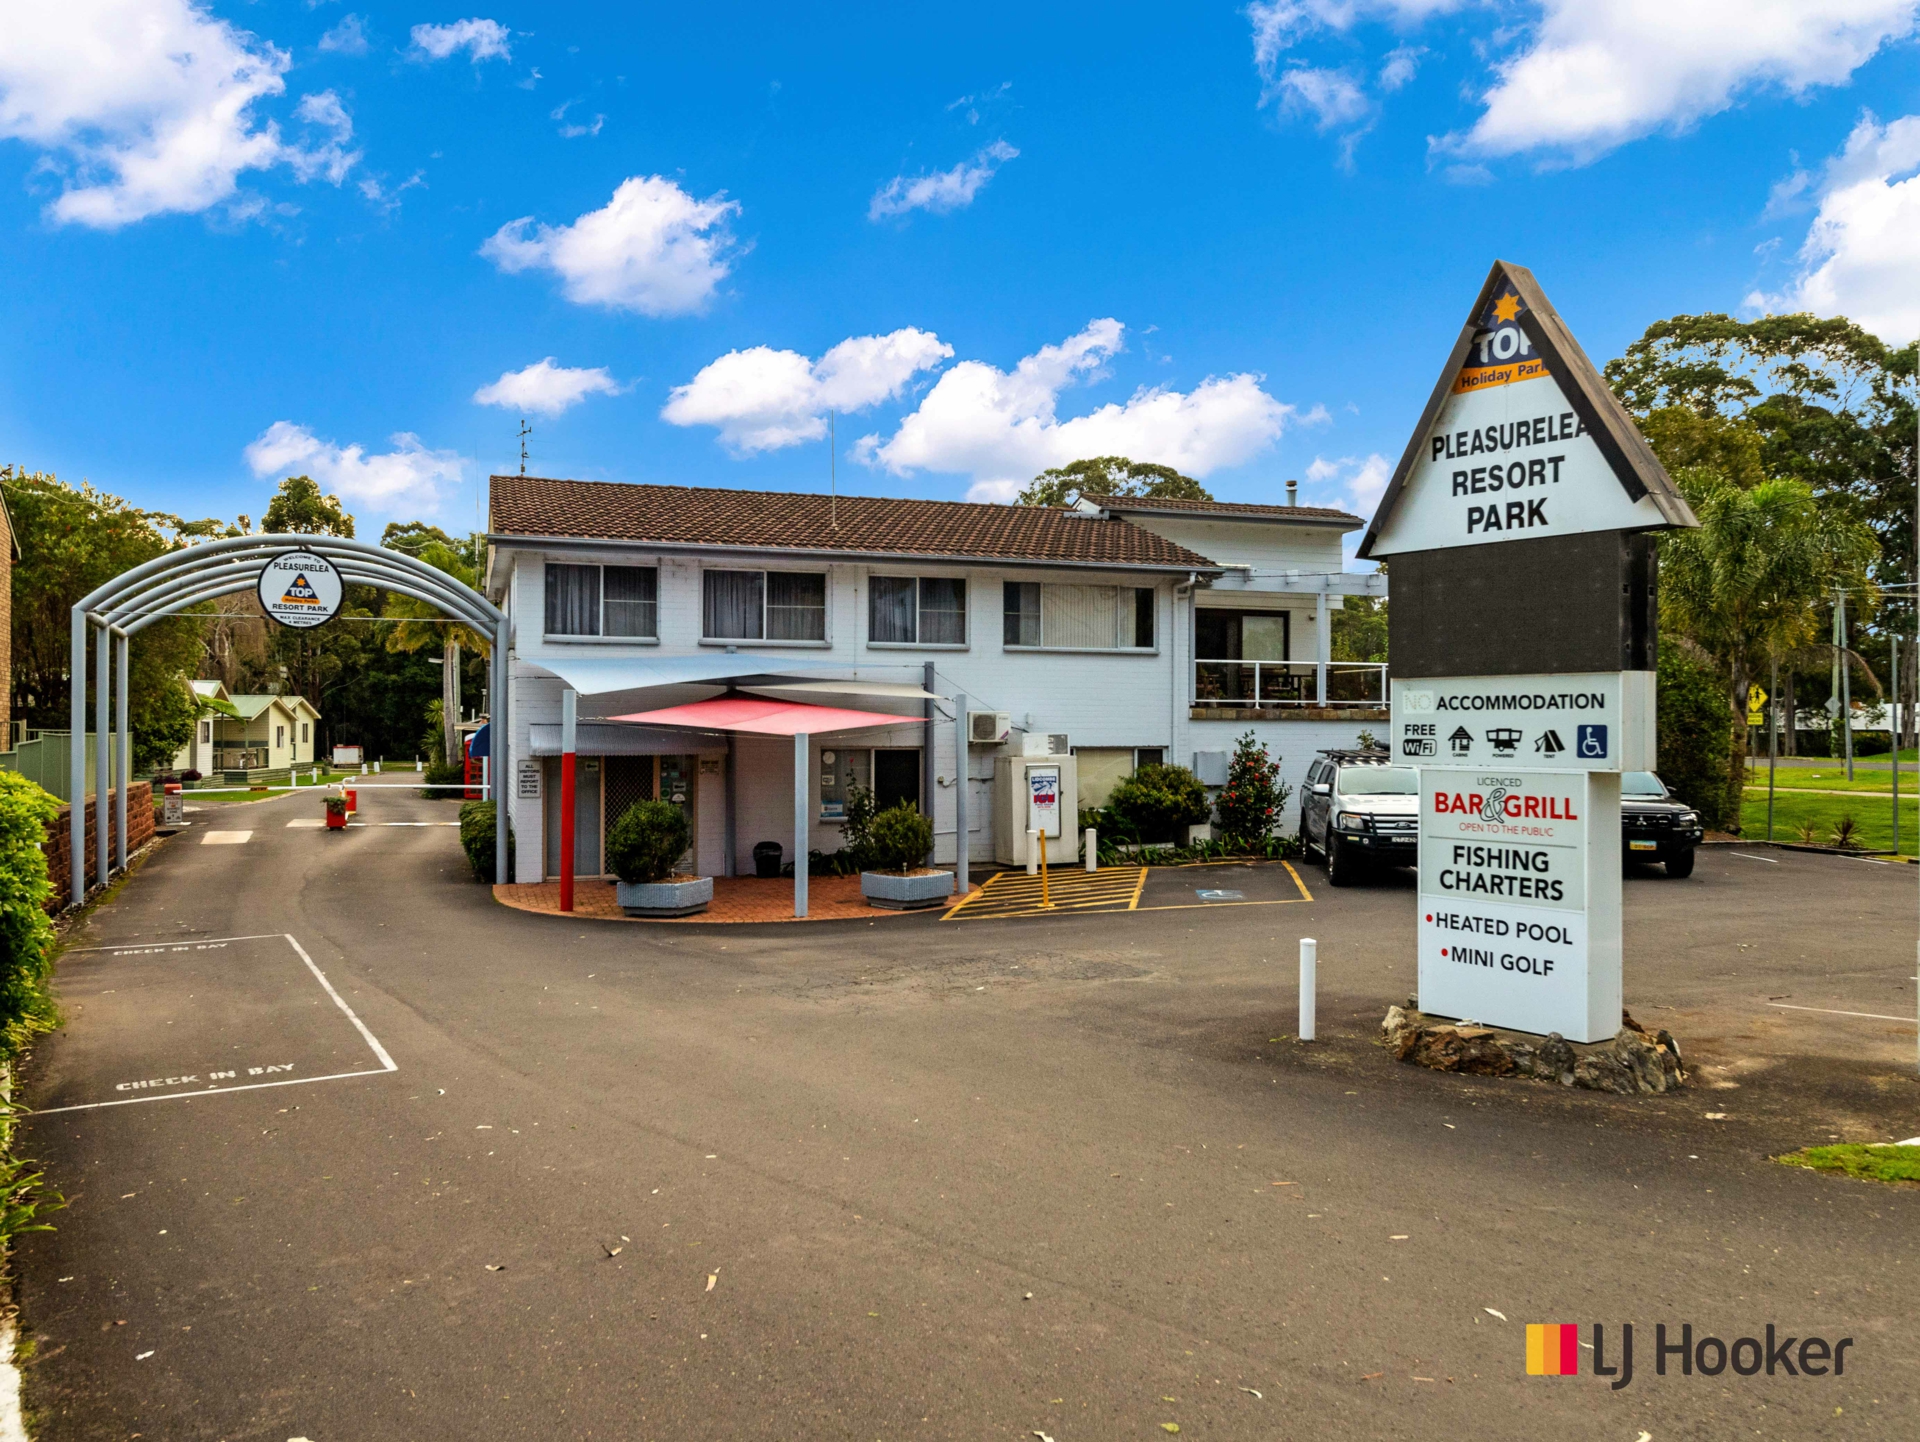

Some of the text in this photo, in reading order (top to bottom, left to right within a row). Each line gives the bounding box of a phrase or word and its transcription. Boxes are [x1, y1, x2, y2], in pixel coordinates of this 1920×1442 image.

[1462, 369, 1513, 388] Holiday
[1432, 412, 1592, 461] PLEASURELEA
[1452, 455, 1565, 497] RESORT
[1467, 498, 1548, 534] PARK
[273, 562, 329, 572] PLEASURELEA
[289, 587, 313, 597] TOP
[1404, 693, 1605, 711] NO ACCOMMODATION
[1404, 724, 1436, 736] FREE
[1477, 777, 1522, 787] LICENCED
[1459, 822, 1554, 837] OPEN TO THE PUBLIC
[1453, 845, 1549, 873] FISHING
[1439, 869, 1563, 901] CHARTERS
[1436, 912, 1573, 945] HEATED POOL
[113, 948, 167, 956] CHECK
[1451, 946, 1554, 976] MINI GOLF
[115, 1062, 295, 1091] CHECK IN BAY
